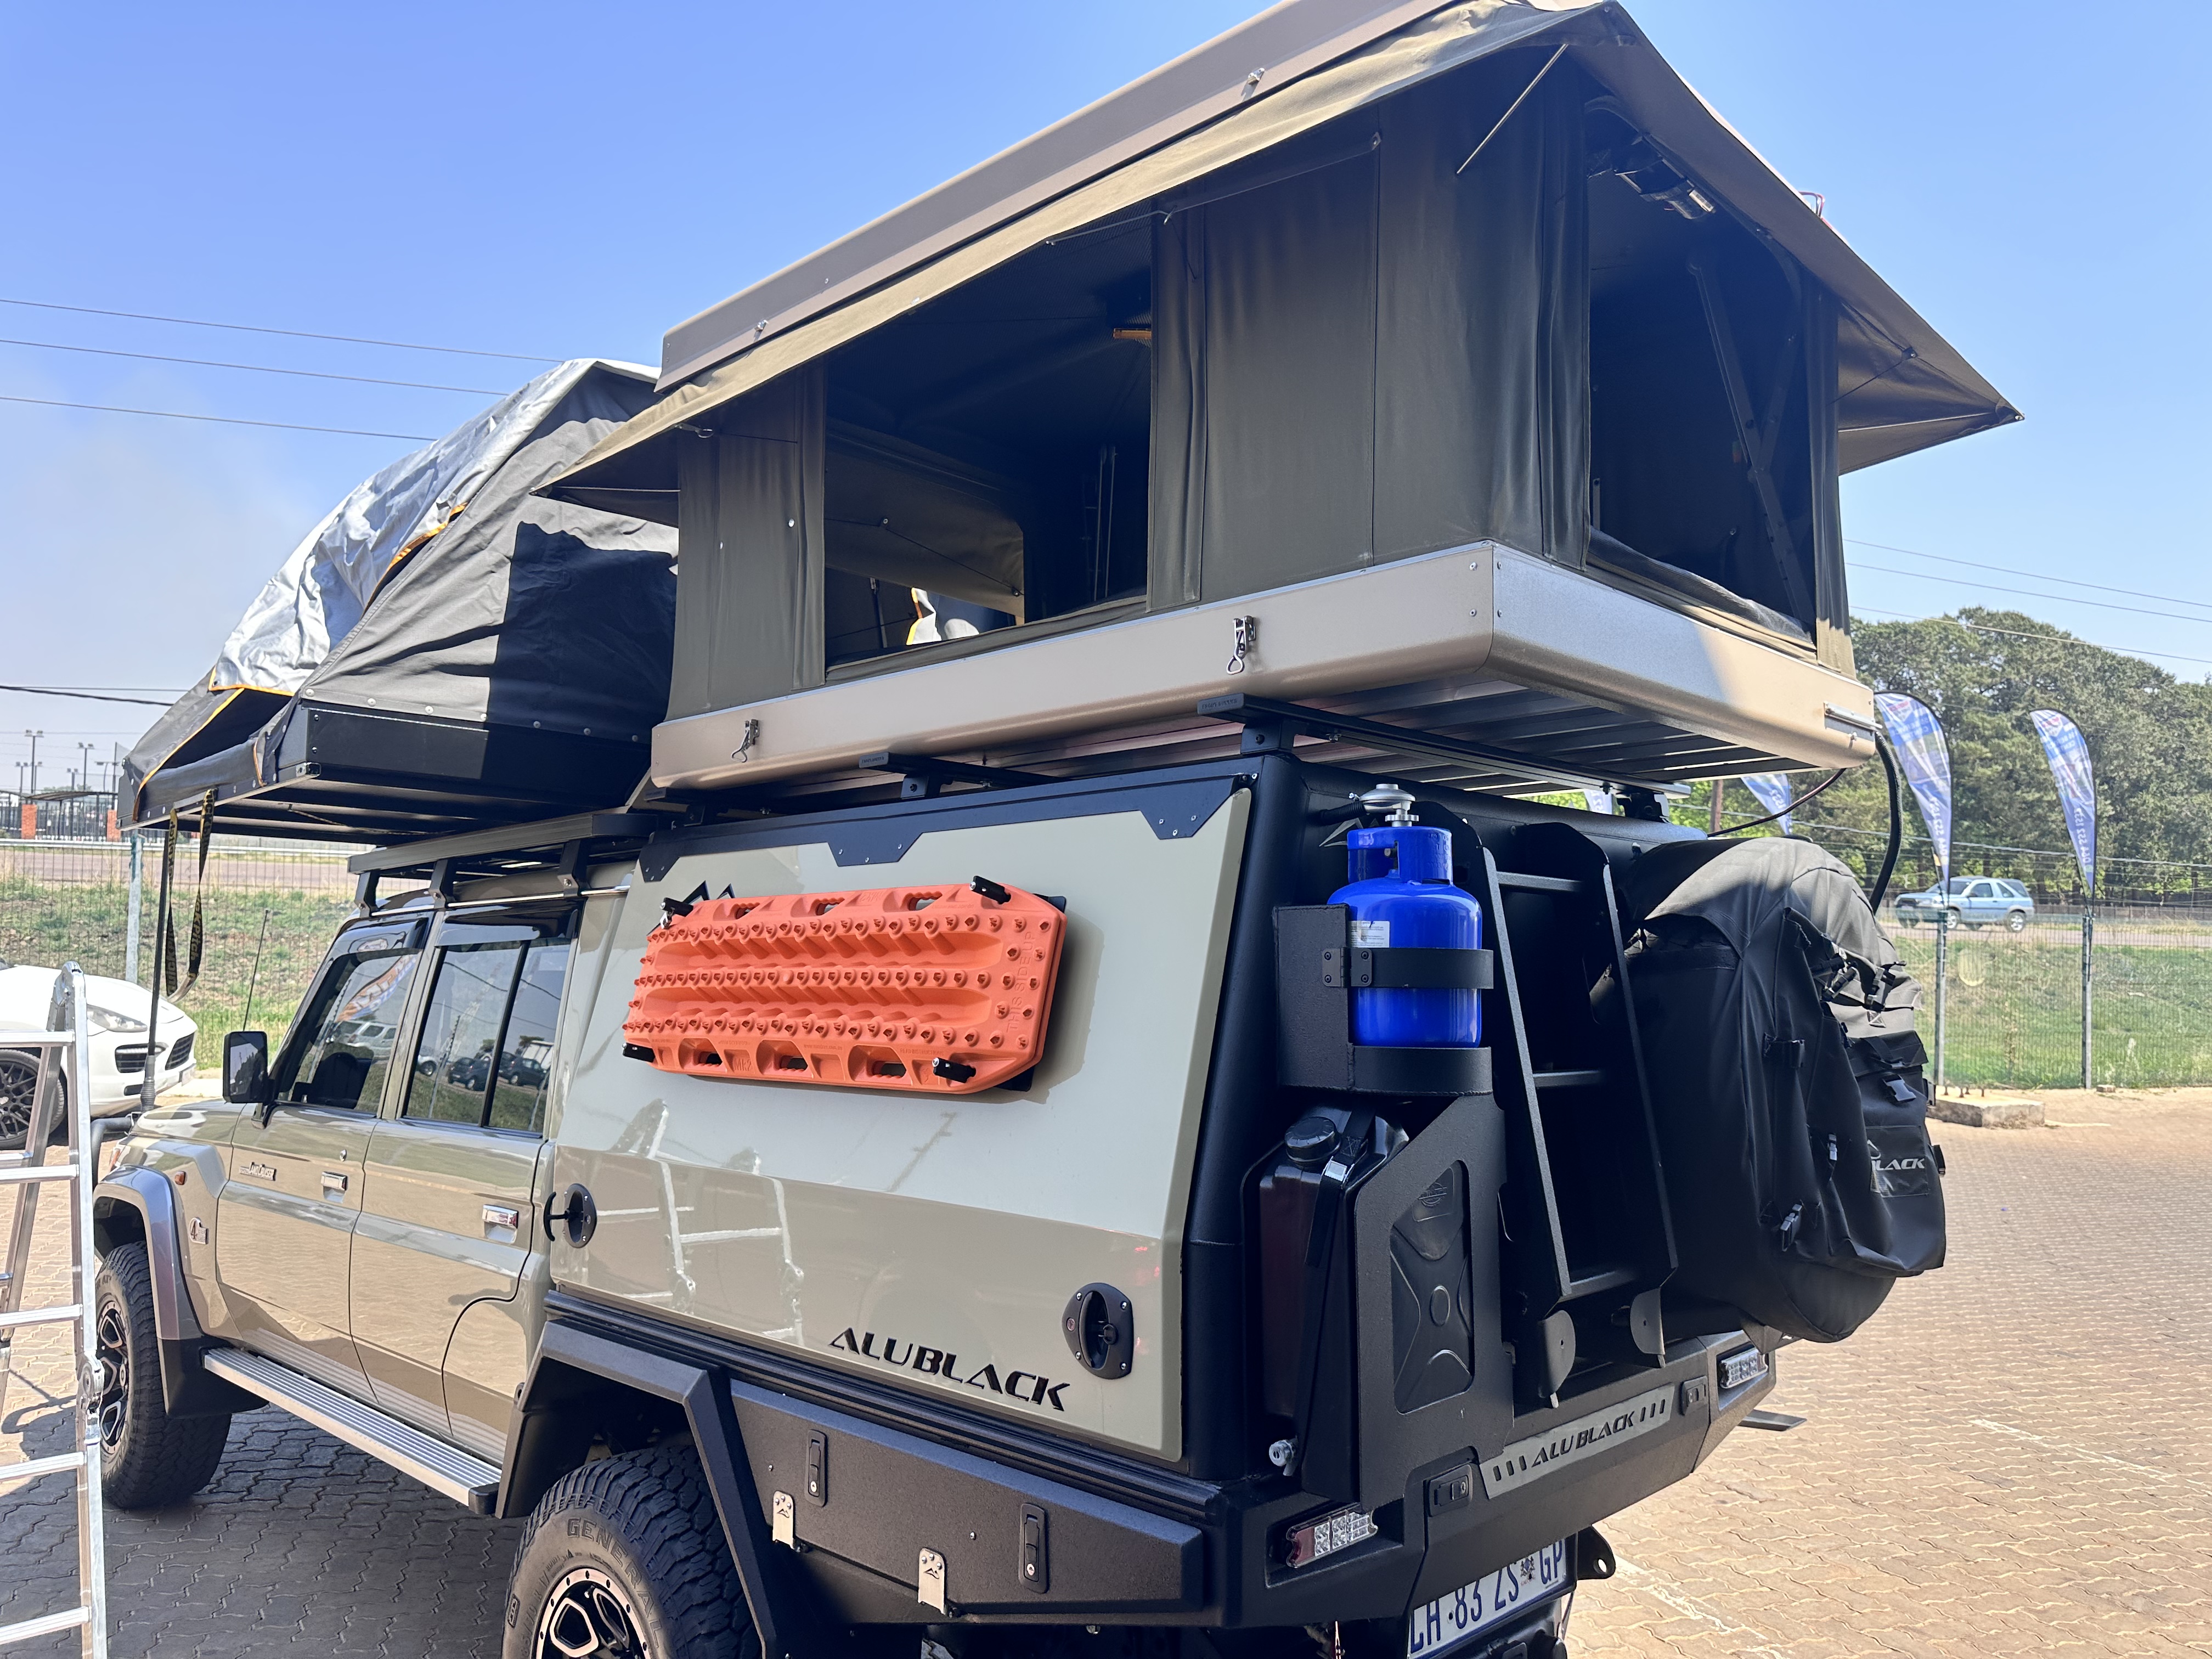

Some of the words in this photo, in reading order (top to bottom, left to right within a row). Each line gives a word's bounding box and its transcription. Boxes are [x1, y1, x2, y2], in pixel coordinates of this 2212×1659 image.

[1022, 931, 1035, 954] UP
[1014, 956, 1031, 992] SIDE
[1006, 996, 1023, 1033] THIS
[828, 1326, 1071, 1412] ALUBLACK
[567, 1517, 663, 1650] GENERAL
[1455, 1579, 1482, 1629] 83
[1494, 1565, 1519, 1611] ZS
[1539, 1540, 1562, 1585] GP
